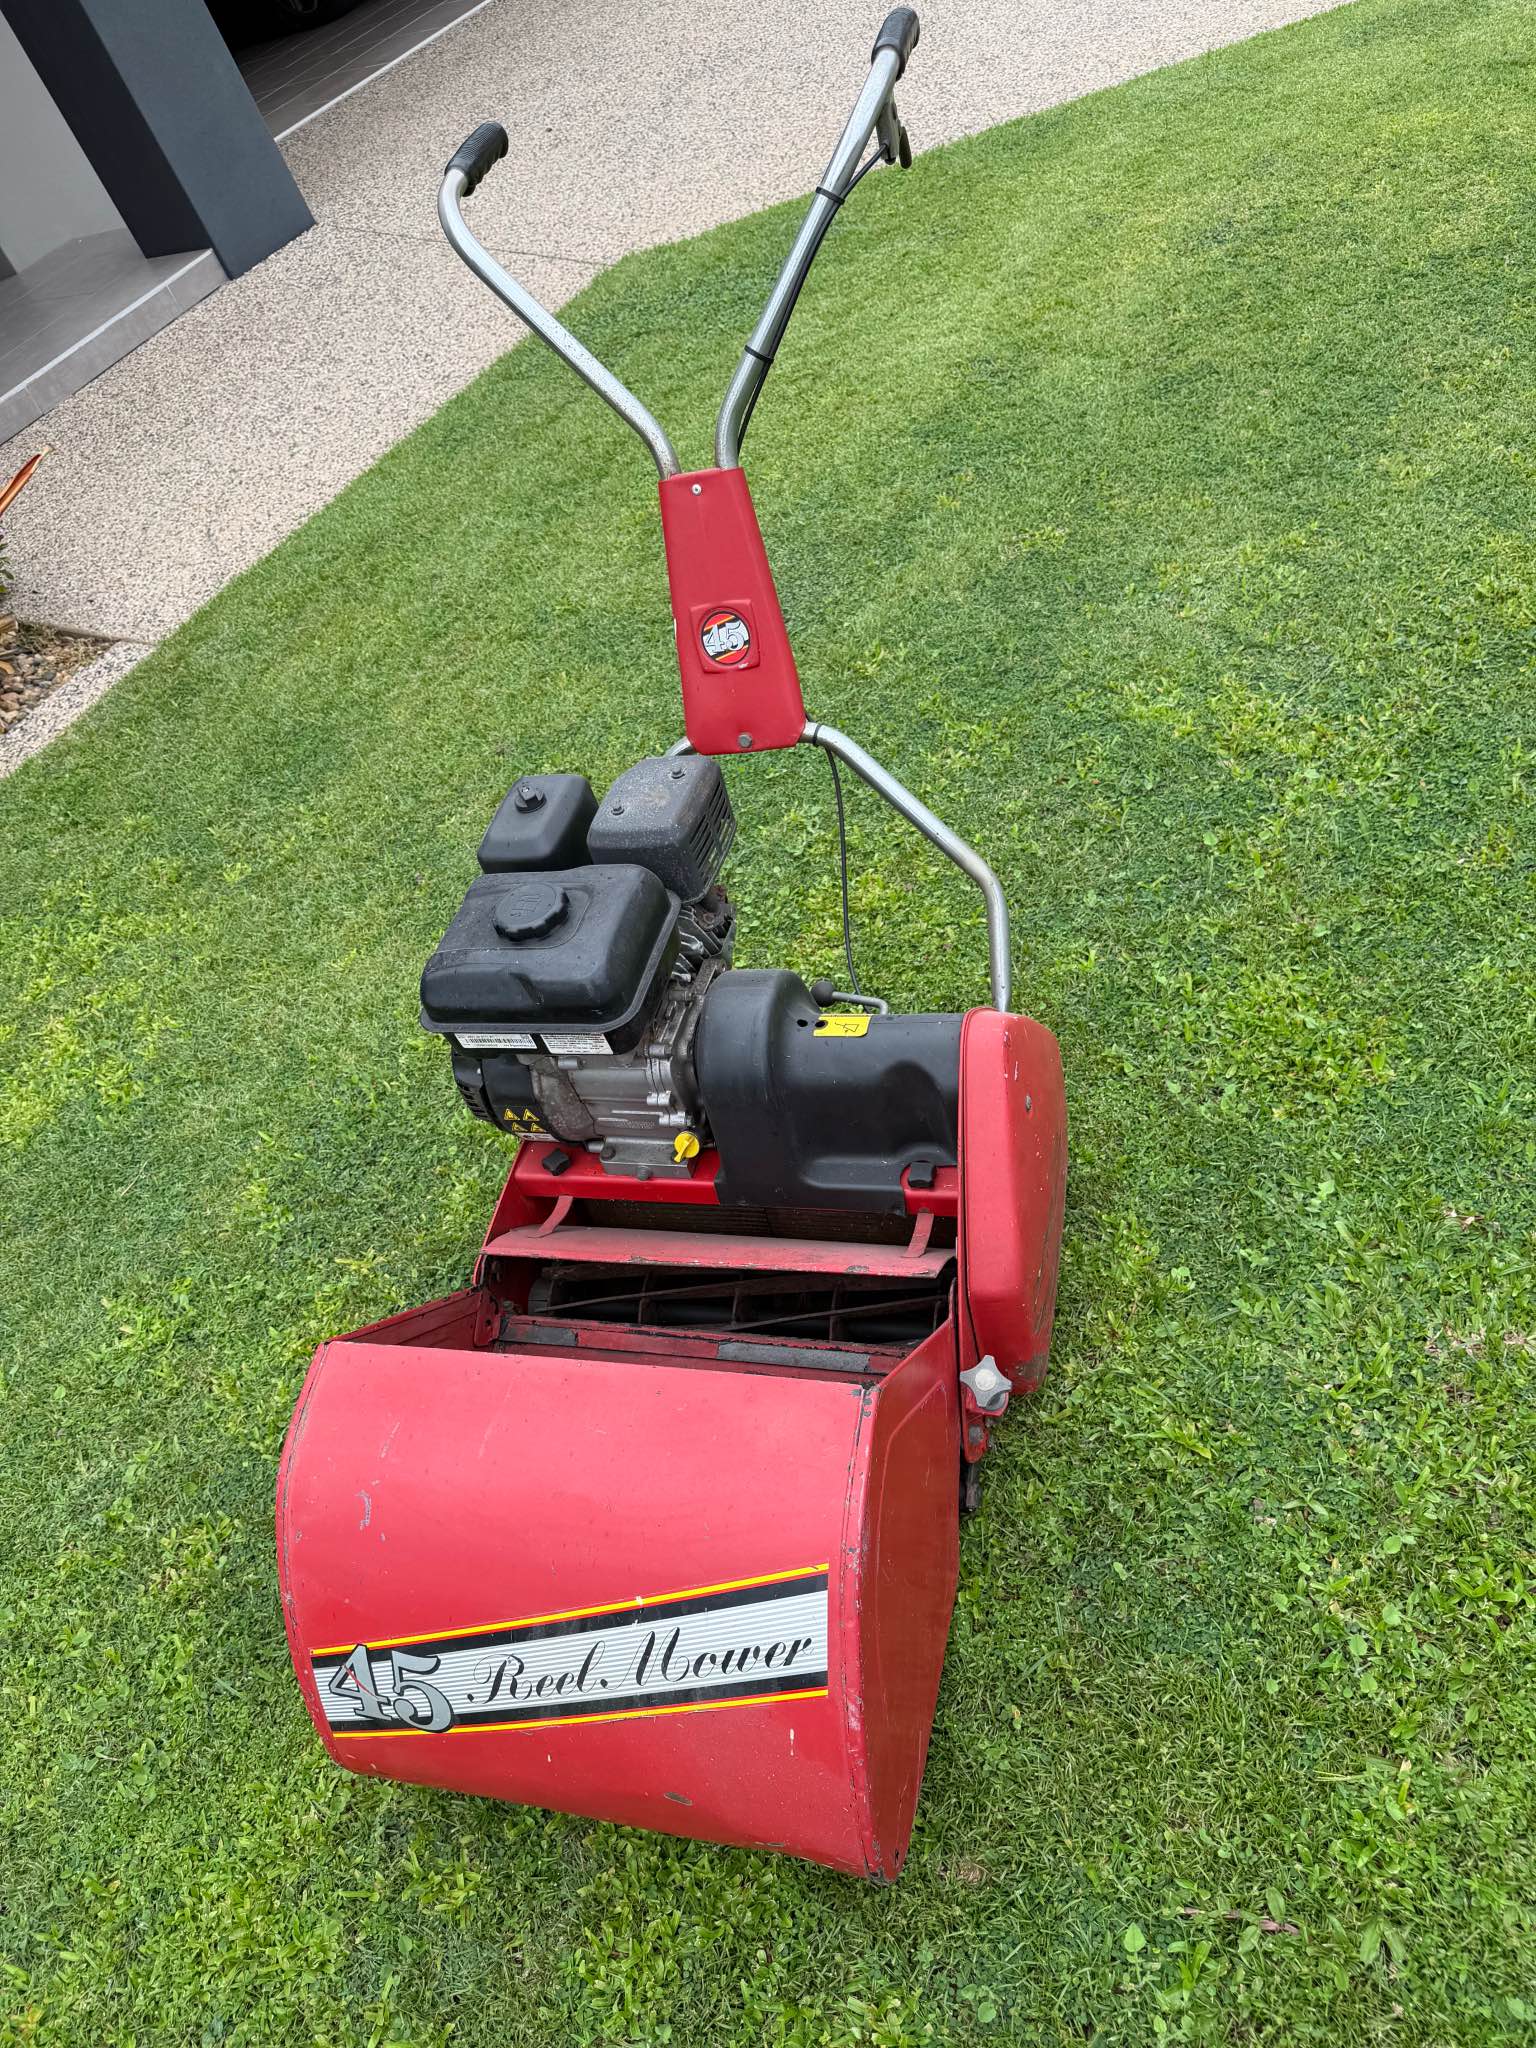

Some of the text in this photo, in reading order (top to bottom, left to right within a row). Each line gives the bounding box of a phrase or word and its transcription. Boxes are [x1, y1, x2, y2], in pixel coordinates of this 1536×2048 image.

[706, 622, 745, 654] 45
[328, 1626, 814, 1733] 45 Reel Mower
